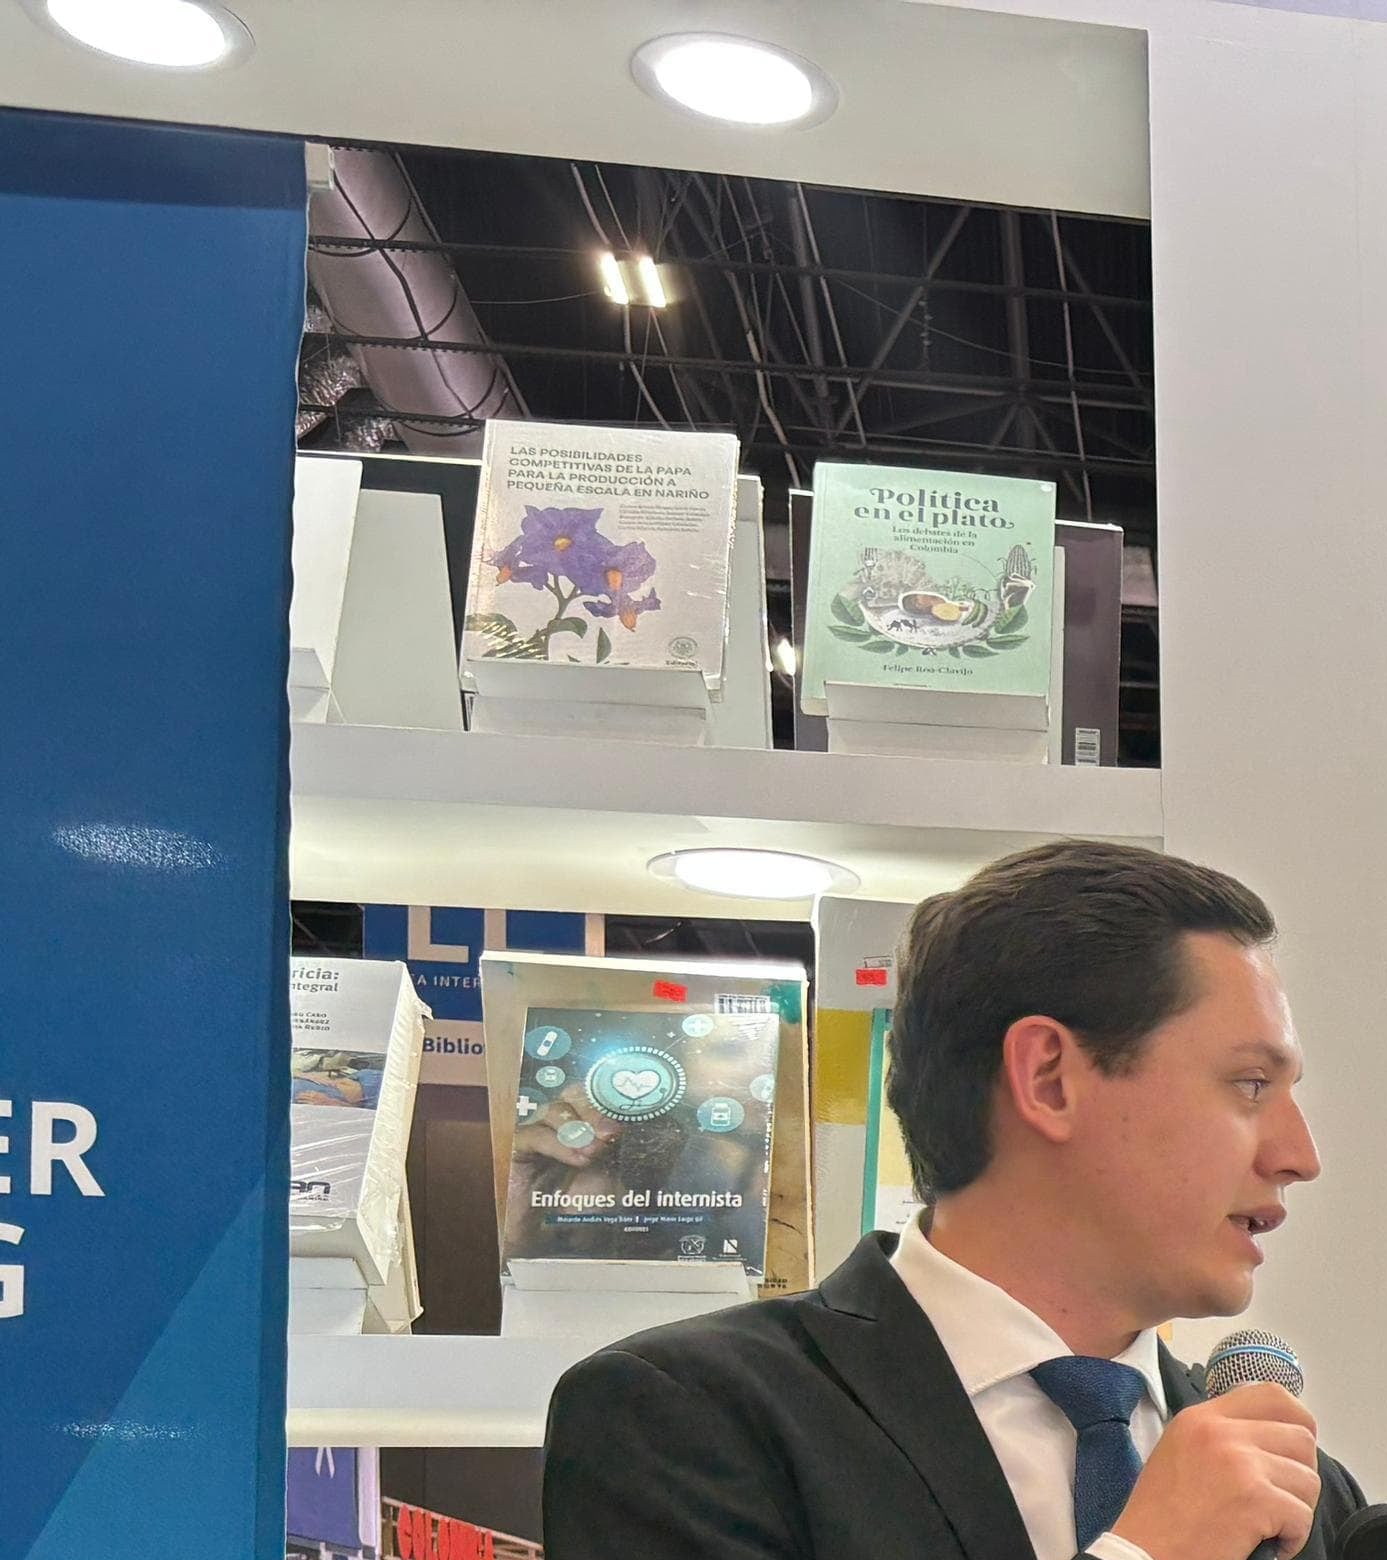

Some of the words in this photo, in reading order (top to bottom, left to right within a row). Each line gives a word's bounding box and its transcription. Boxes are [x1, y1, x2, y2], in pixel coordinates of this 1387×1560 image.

[511, 446, 536, 456] LAS
[540, 449, 642, 462] POSIBILIDADES
[510, 459, 611, 472] COMPETITIVAS
[616, 465, 633, 473] DE
[637, 466, 652, 474] LA
[657, 467, 691, 475] PAPA
[508, 470, 544, 479] PARA
[549, 472, 565, 480] LA
[569, 473, 663, 485] PRODUCCIÓN
[508, 481, 573, 493] PEQUEÑA
[577, 486, 630, 496] ESCALA
[634, 489, 651, 497] EN
[656, 489, 709, 499] NARIÑO
[855, 507, 890, 520] en
[900, 508, 924, 522] el
[933, 510, 1015, 529] plato
[0, 1100, 105, 1196] R
[532, 1190, 615, 1212] Enfoques
[623, 1190, 649, 1207] del
[658, 1190, 742, 1207] internista
